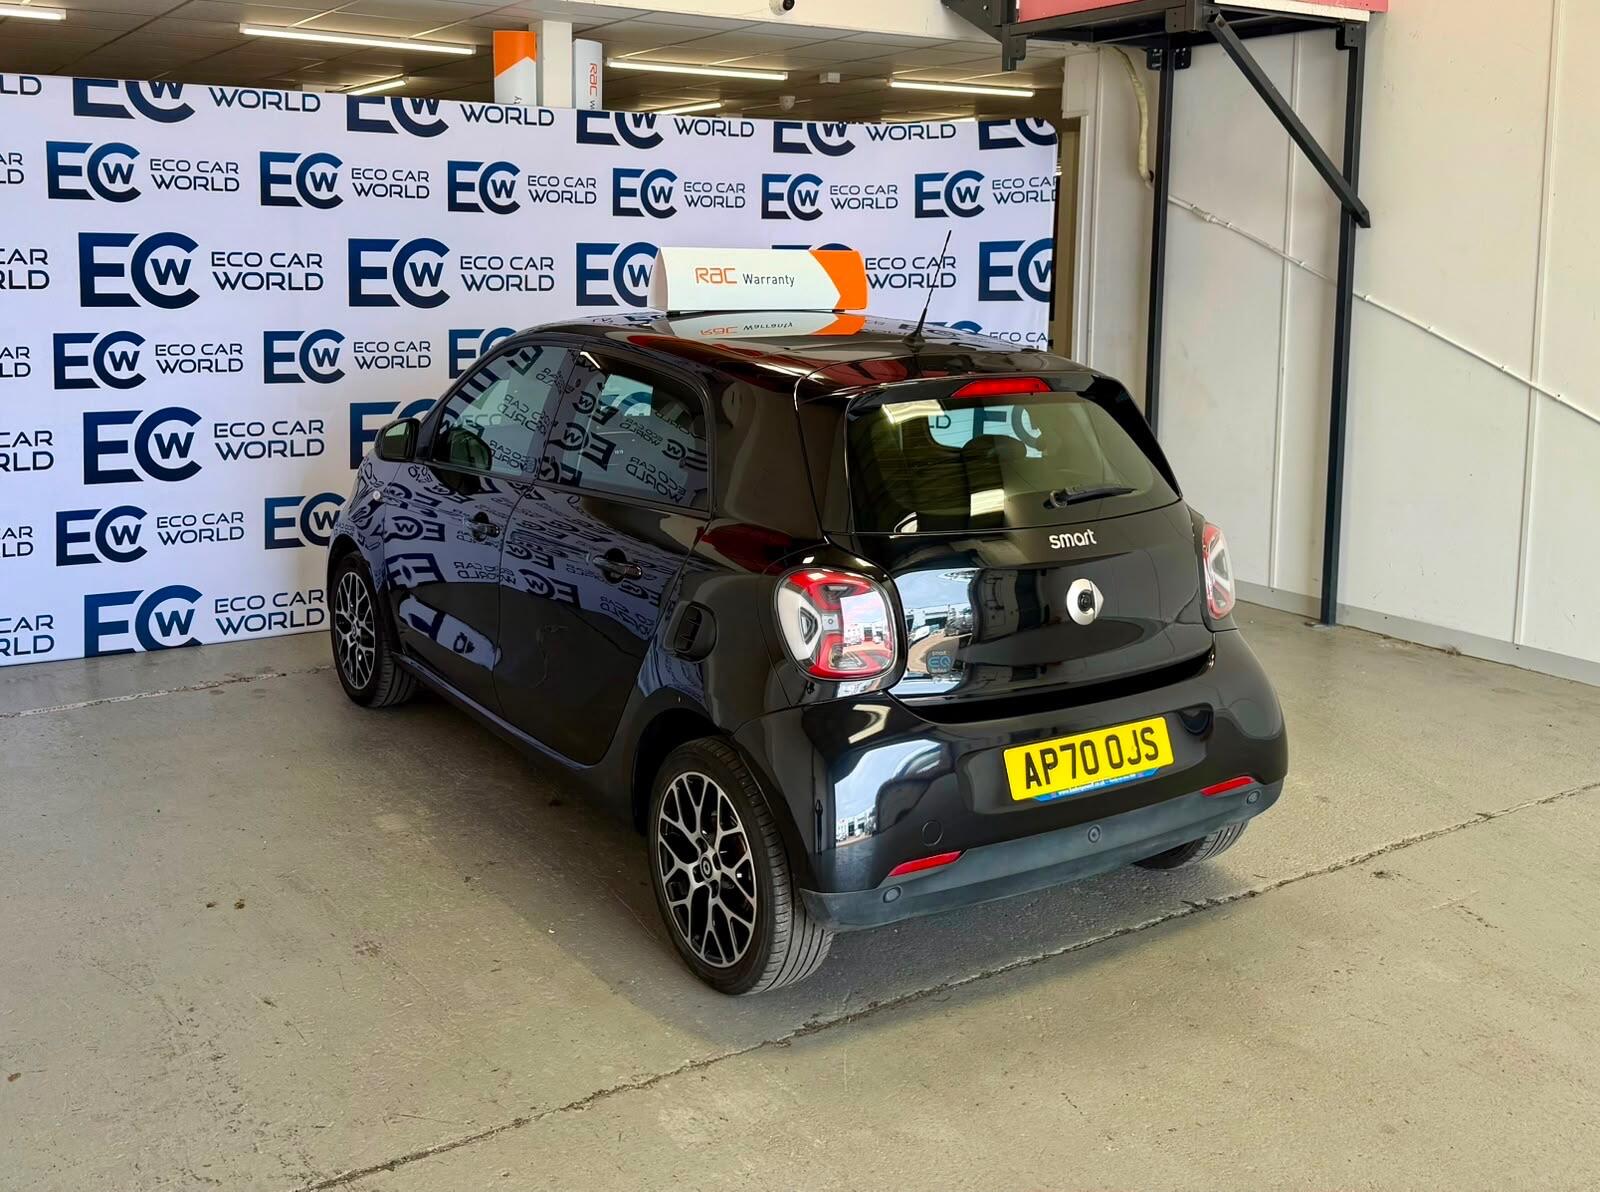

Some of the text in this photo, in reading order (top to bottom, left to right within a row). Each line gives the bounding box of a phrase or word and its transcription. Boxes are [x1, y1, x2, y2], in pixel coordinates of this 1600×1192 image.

[208, 87, 321, 112] WORLD
[460, 104, 555, 127] WORLD
[673, 117, 755, 137] WORLD
[865, 124, 957, 142] WORLD
[150, 159, 239, 174] ECO CAR
[151, 174, 239, 192] WORLD
[352, 168, 429, 183] ECO CAR
[528, 175, 596, 188] ECO CAR
[352, 182, 430, 199] WORLD
[684, 182, 745, 194] ECO CAR
[830, 185, 897, 195] ECO CAR
[992, 179, 1024, 189] ECO
[528, 189, 597, 204] WORLD
[684, 195, 745, 208] WORLD
[830, 197, 898, 209] WORLD
[0, 248, 48, 265] AR
[211, 251, 323, 268] ECO CAR
[460, 256, 554, 271] ECO CAR
[865, 256, 956, 270] ECO CAR
[212, 271, 324, 291] WORLD
[461, 274, 554, 292] WORLD
[742, 274, 795, 287] Warranty
[867, 273, 956, 289] WORLD
[155, 343, 243, 356] ECO CAR
[354, 341, 431, 353] ECO CAR
[156, 358, 243, 374] WORLD
[354, 355, 431, 370] WORLD
[214, 419, 324, 438] ECO CAR
[215, 438, 324, 461] WORLD
[157, 512, 244, 528] ECO CAR
[157, 526, 245, 546] WORLD
[1049, 528, 1097, 549] smart
[215, 589, 324, 614] ECO CAR
[215, 607, 325, 636] WORLD
[1024, 743, 1099, 789] AP70
